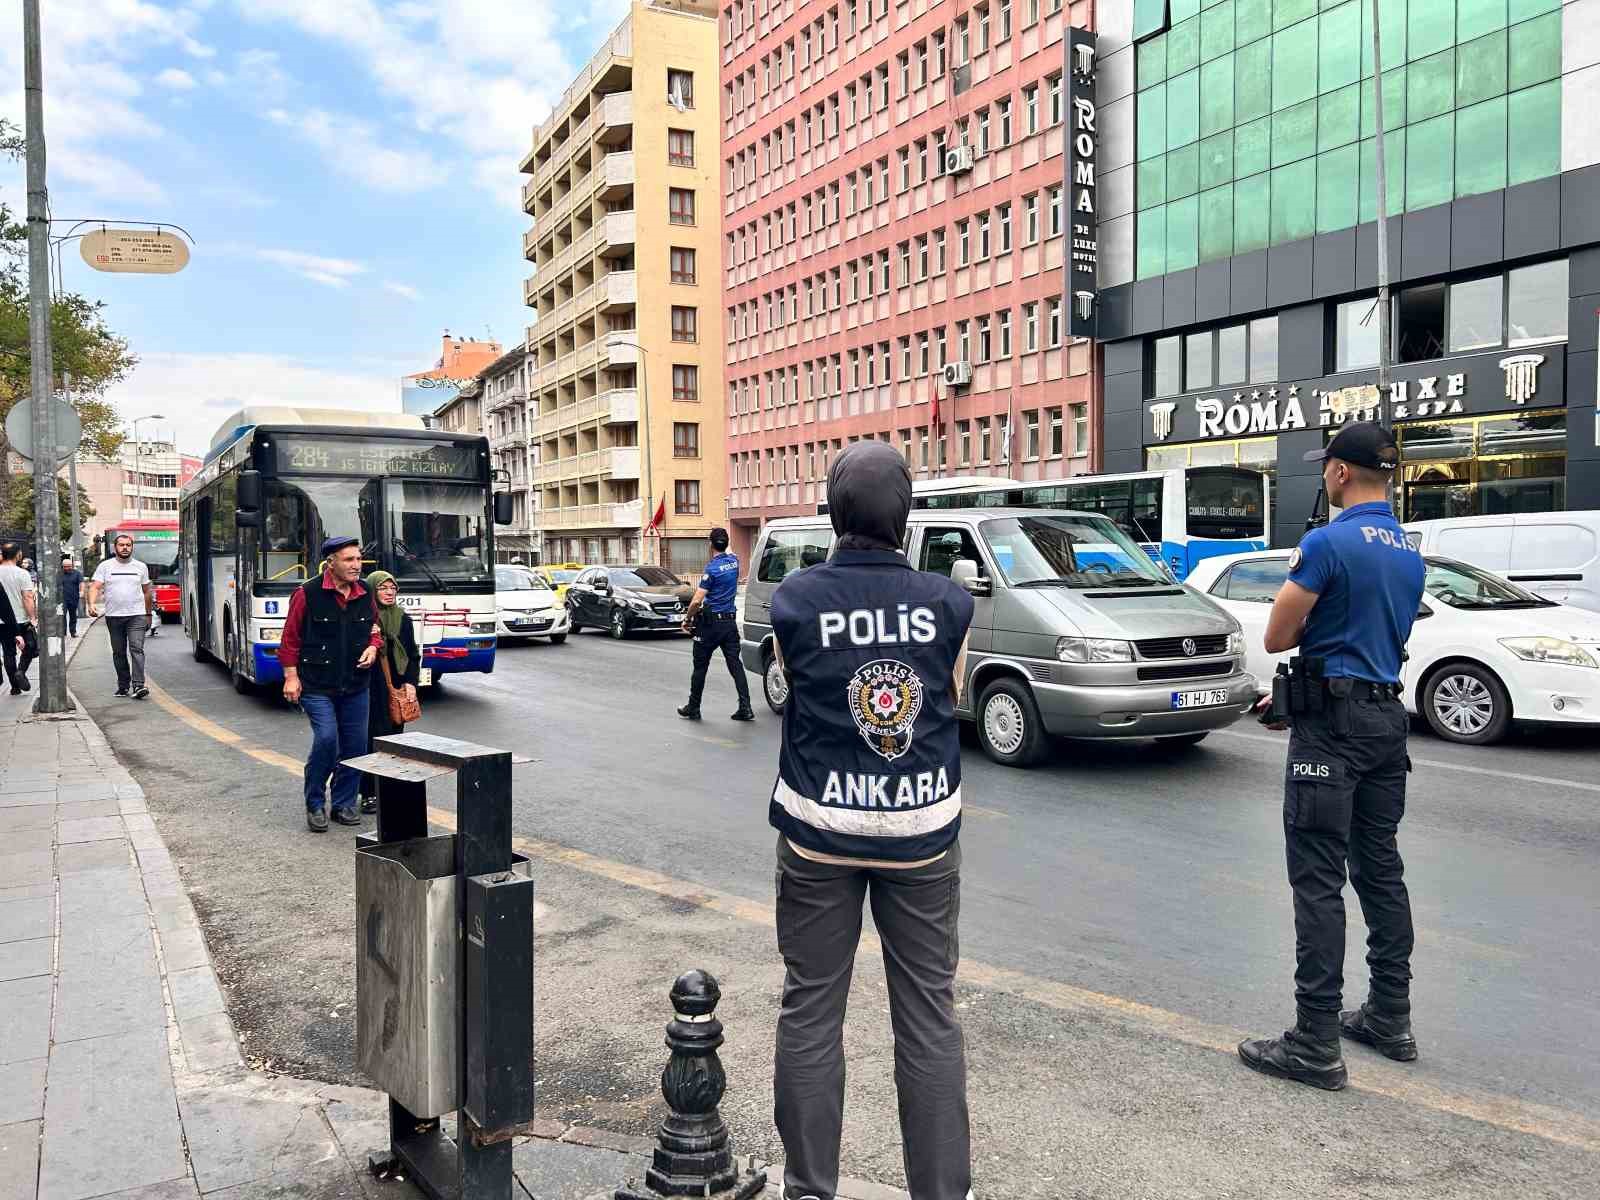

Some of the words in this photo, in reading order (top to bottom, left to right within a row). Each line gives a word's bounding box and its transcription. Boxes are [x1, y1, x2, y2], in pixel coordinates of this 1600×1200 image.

[1074, 96, 1095, 213] ROMA
[1073, 239, 1096, 250] LUXE
[1195, 397, 1306, 437] ROMA
[1395, 405, 1410, 418] &
[1417, 400, 1463, 415] SPA
[292, 447, 329, 468] 284
[1360, 526, 1418, 552] POLİS
[398, 597, 422, 606] 201
[819, 604, 937, 648] POLİS
[862, 663, 908, 680] POLİS
[1178, 694, 1188, 706] 61
[1193, 692, 1207, 705] HJ
[1211, 690, 1226, 703] 763
[1292, 763, 1329, 777] POLİS
[821, 765, 949, 808] ANKARA
